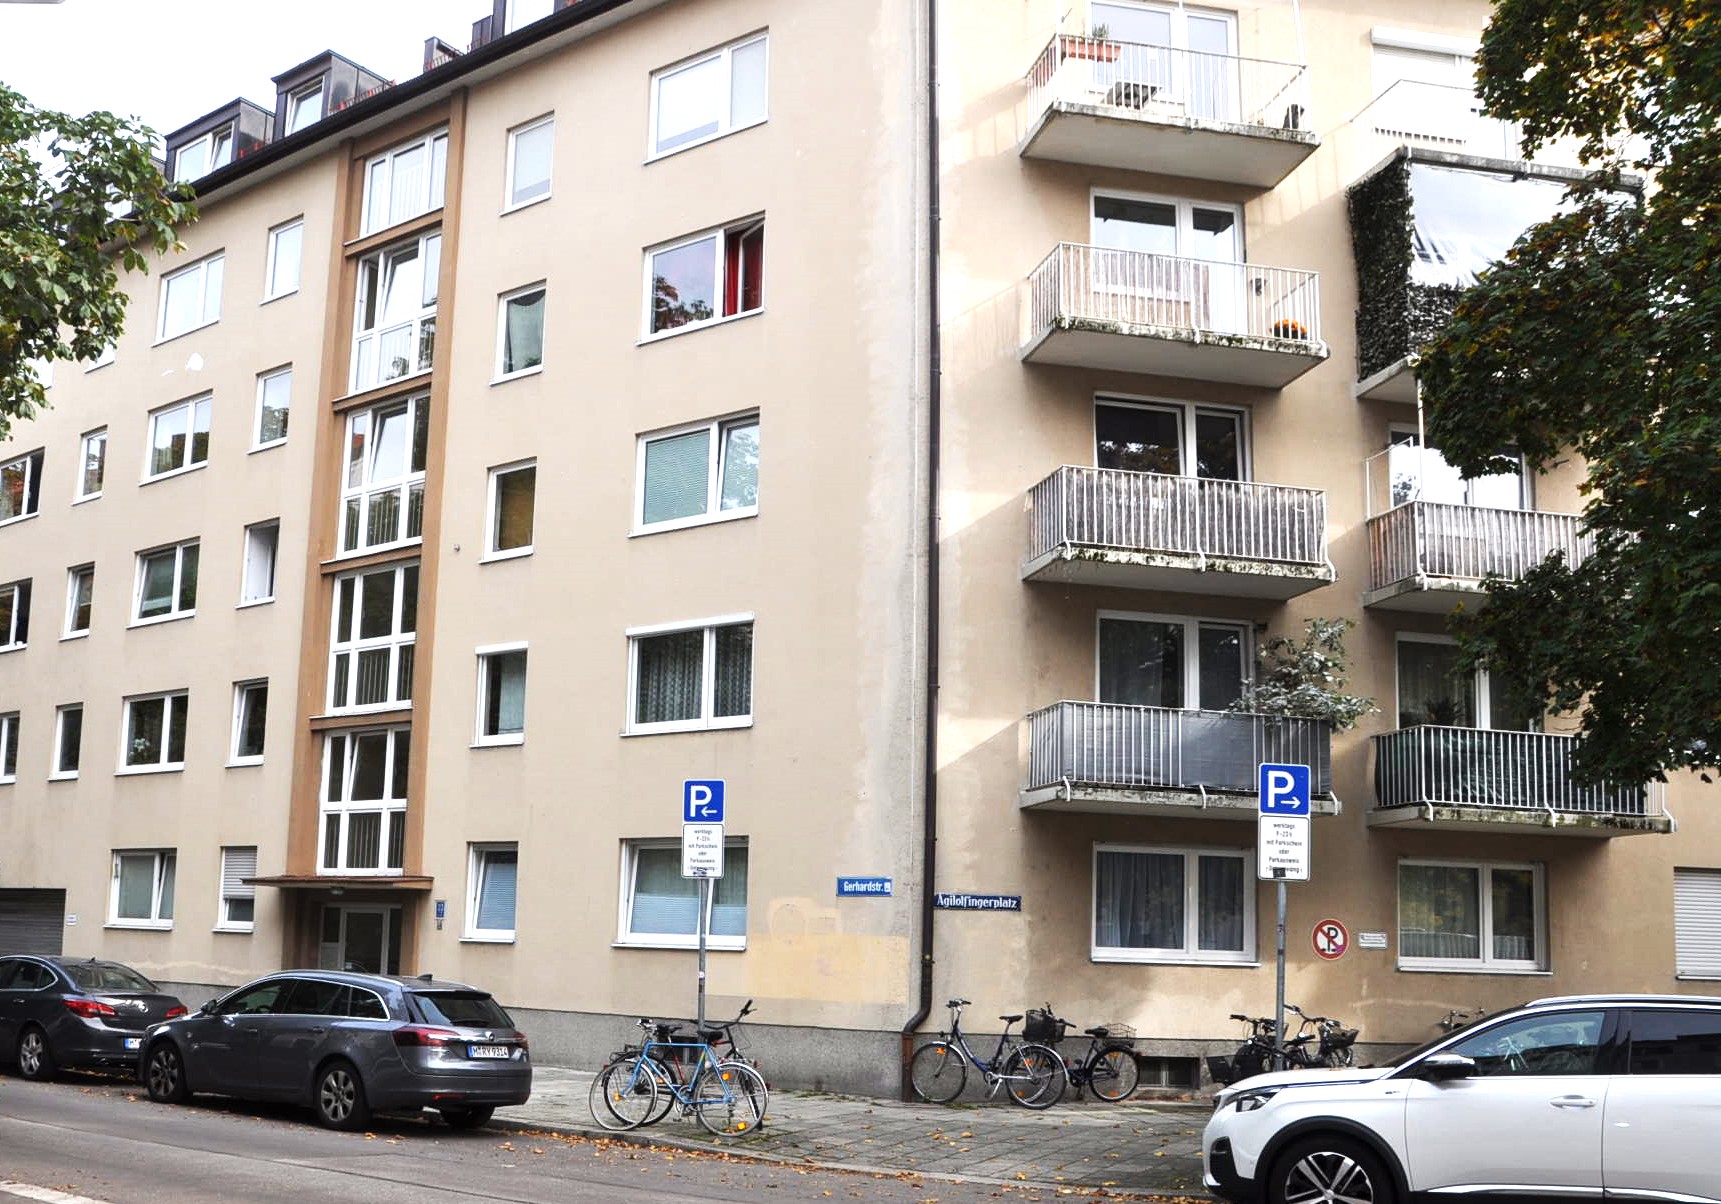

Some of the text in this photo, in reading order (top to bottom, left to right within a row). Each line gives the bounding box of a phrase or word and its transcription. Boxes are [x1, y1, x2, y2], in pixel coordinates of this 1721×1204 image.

[1267, 770, 1295, 808] P
[690, 785, 713, 818] P
[843, 880, 884, 892] Gerhardstr.
[937, 893, 1018, 909] Agilolfingerplatz
